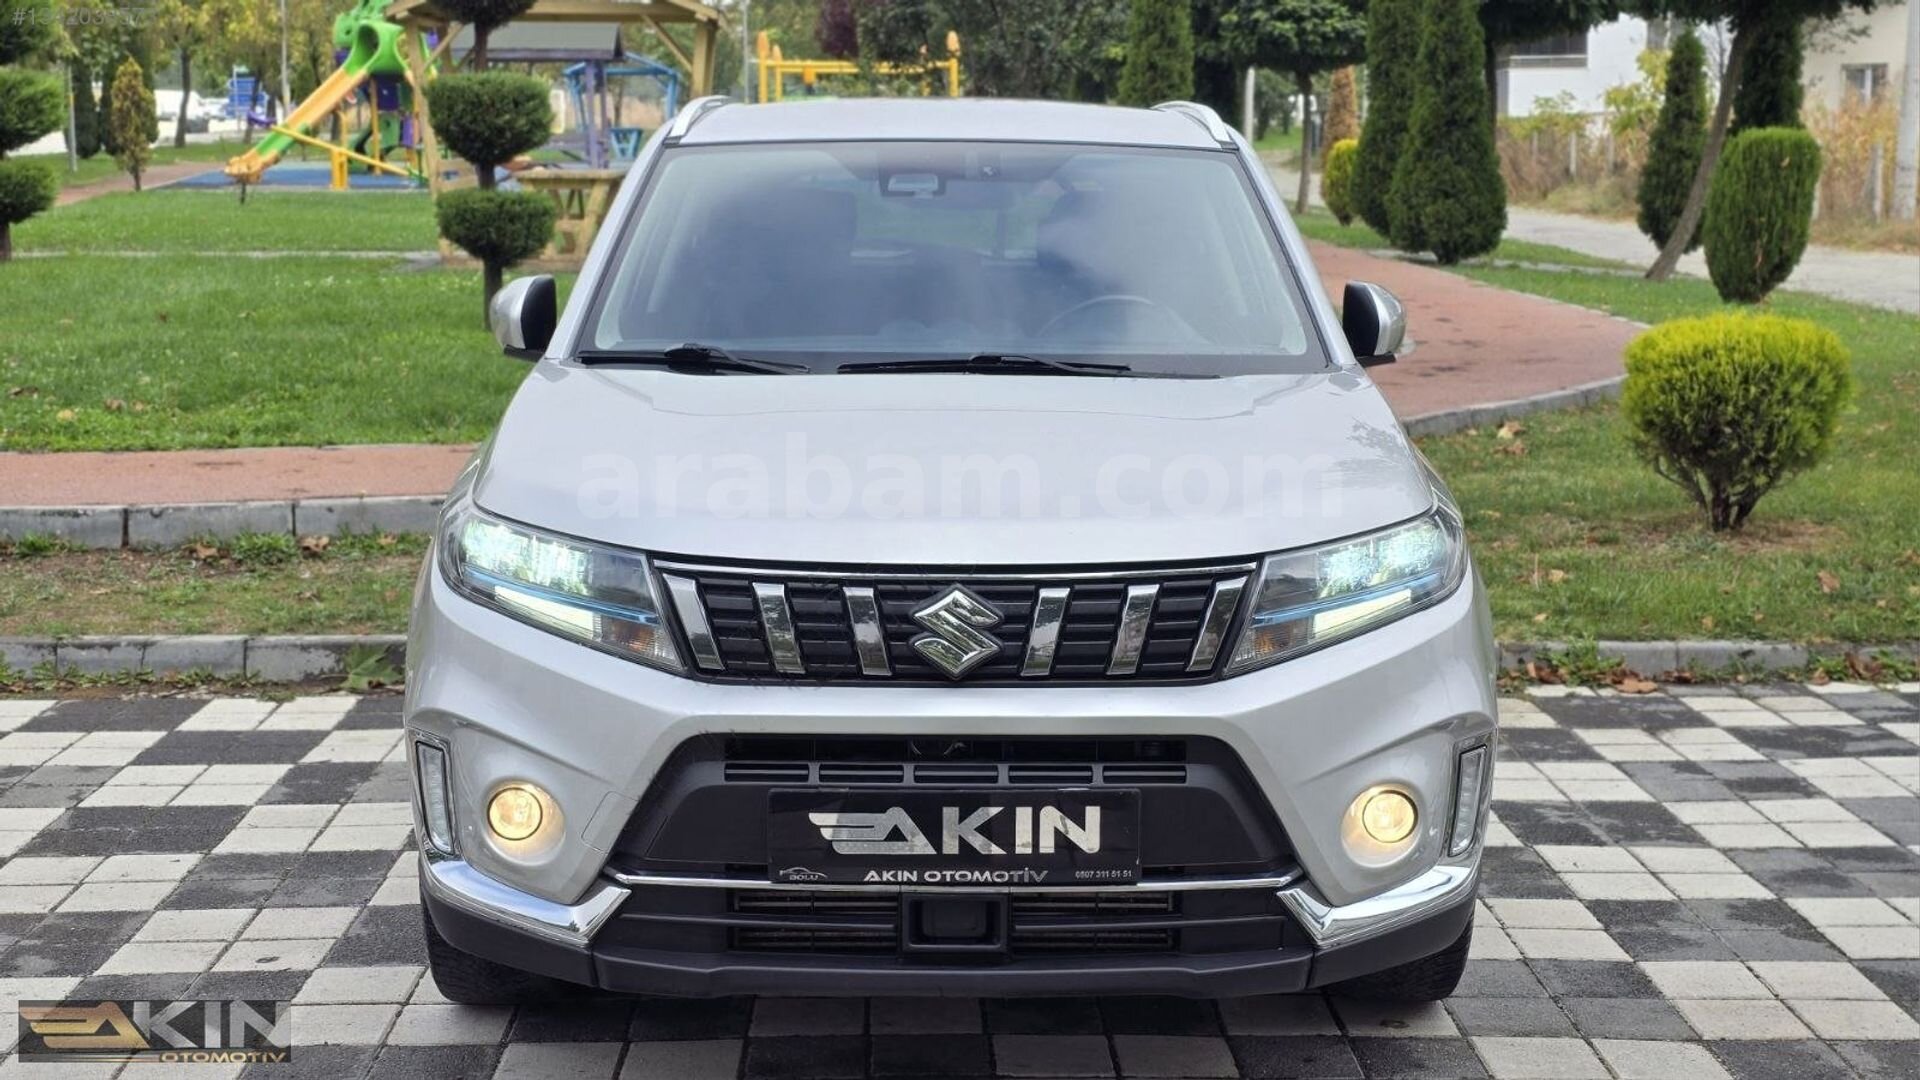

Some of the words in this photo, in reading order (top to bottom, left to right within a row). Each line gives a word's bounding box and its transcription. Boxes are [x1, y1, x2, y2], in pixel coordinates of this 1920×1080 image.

[808, 806, 1100, 854] AKIN
[863, 870, 917, 882] AKIN
[923, 867, 1048, 882] OTOMOTİV
